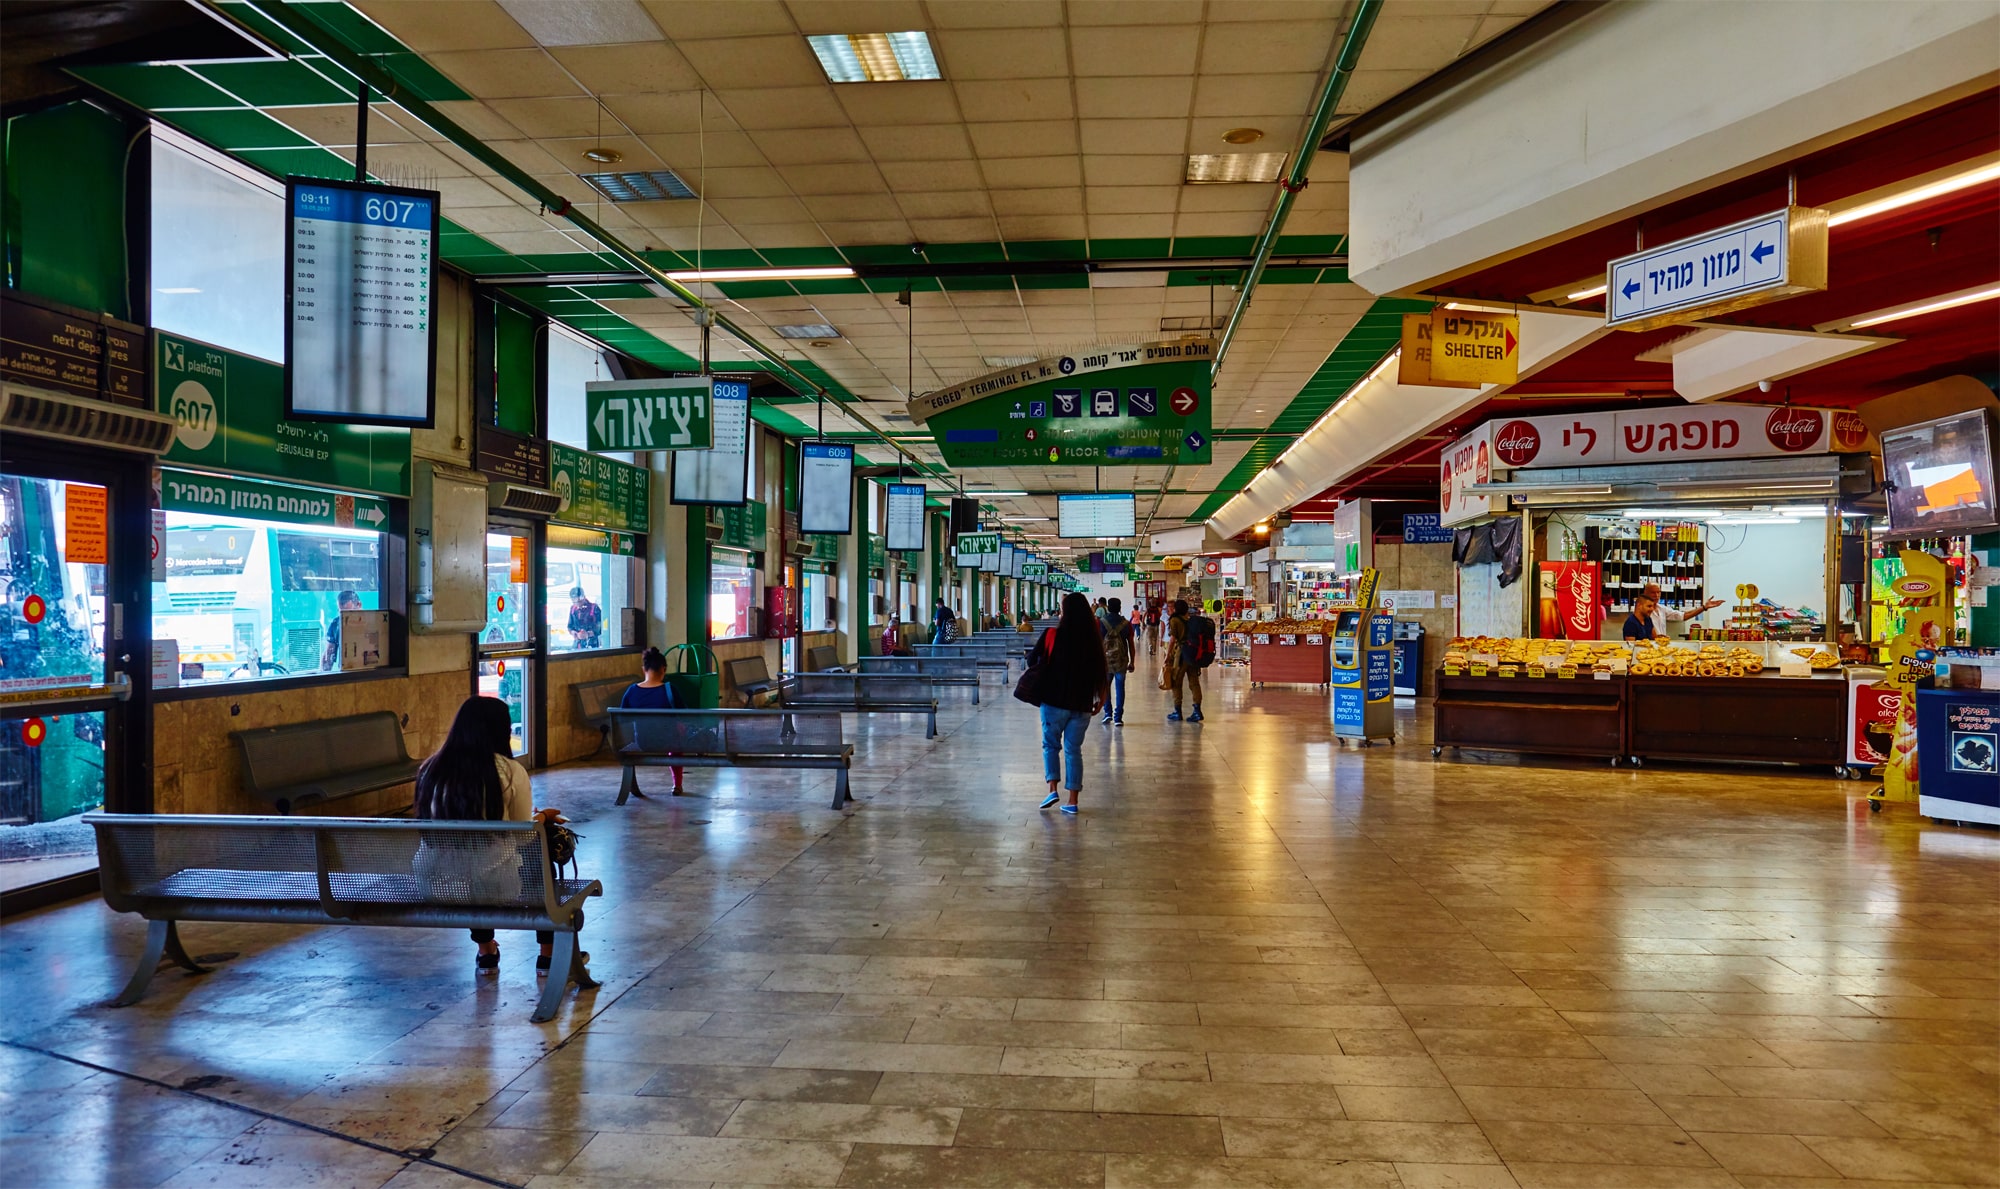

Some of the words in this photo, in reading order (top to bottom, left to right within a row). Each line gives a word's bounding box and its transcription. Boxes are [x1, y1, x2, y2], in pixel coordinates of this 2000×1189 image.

[301, 193, 329, 205] 09:11
[366, 198, 414, 223] 607
[1702, 248, 1740, 287] מזון
[1649, 261, 1693, 294] מהיר
[65, 324, 93, 339] הבאות
[1444, 317, 1504, 340] מקלט
[52, 335, 74, 348] next
[78, 340, 128, 362] depaures
[1147, 346, 1181, 359] נוסעים
[1186, 342, 1209, 356] אולם
[1445, 342, 1503, 360] SHELTER
[206, 352, 222, 364] רציף
[1063, 360, 1072, 372] 6
[1083, 354, 1108, 368] קומה
[11, 359, 56, 376] destination
[188, 360, 222, 377] platform
[970, 374, 1018, 396] TERMINAL
[1021, 370, 1036, 382] FL.
[1039, 366, 1054, 377] No.
[714, 384, 739, 398] 608
[174, 398, 212, 432] 607
[608, 395, 704, 448] יציאה
[277, 422, 306, 438] ירושלים
[1118, 428, 1160, 439] אוטובוס
[1164, 428, 1184, 440] קווי
[1770, 418, 1816, 435] Coca-Cola
[1027, 430, 1034, 440] 4
[1498, 436, 1536, 450] Coca-Cola
[1563, 422, 1597, 456] לי
[1624, 420, 1740, 454] מפגש
[276, 442, 314, 458] JERUSALEM
[317, 450, 329, 460] EXP
[828, 448, 846, 458] 609
[1065, 448, 1099, 456] FLOOR
[578, 457, 590, 476] 521
[1454, 444, 1474, 476] מפגש
[598, 462, 610, 480] 524
[618, 468, 628, 484] 525
[635, 472, 646, 488] 531
[168, 482, 226, 505] המהיר
[230, 490, 272, 510] המזון
[276, 496, 330, 517] למתחם
[1406, 515, 1438, 526] כנסת
[1404, 526, 1415, 542] 6
[965, 537, 996, 553] יציאה
[176, 557, 224, 566] Mercedes-Benz
[1109, 550, 1134, 563] יציאה
[1024, 564, 1044, 575] יציאה
[1571, 568, 1592, 632] Coca-Cola
[1739, 588, 1744, 596] 7
[1246, 610, 1254, 620] 6
